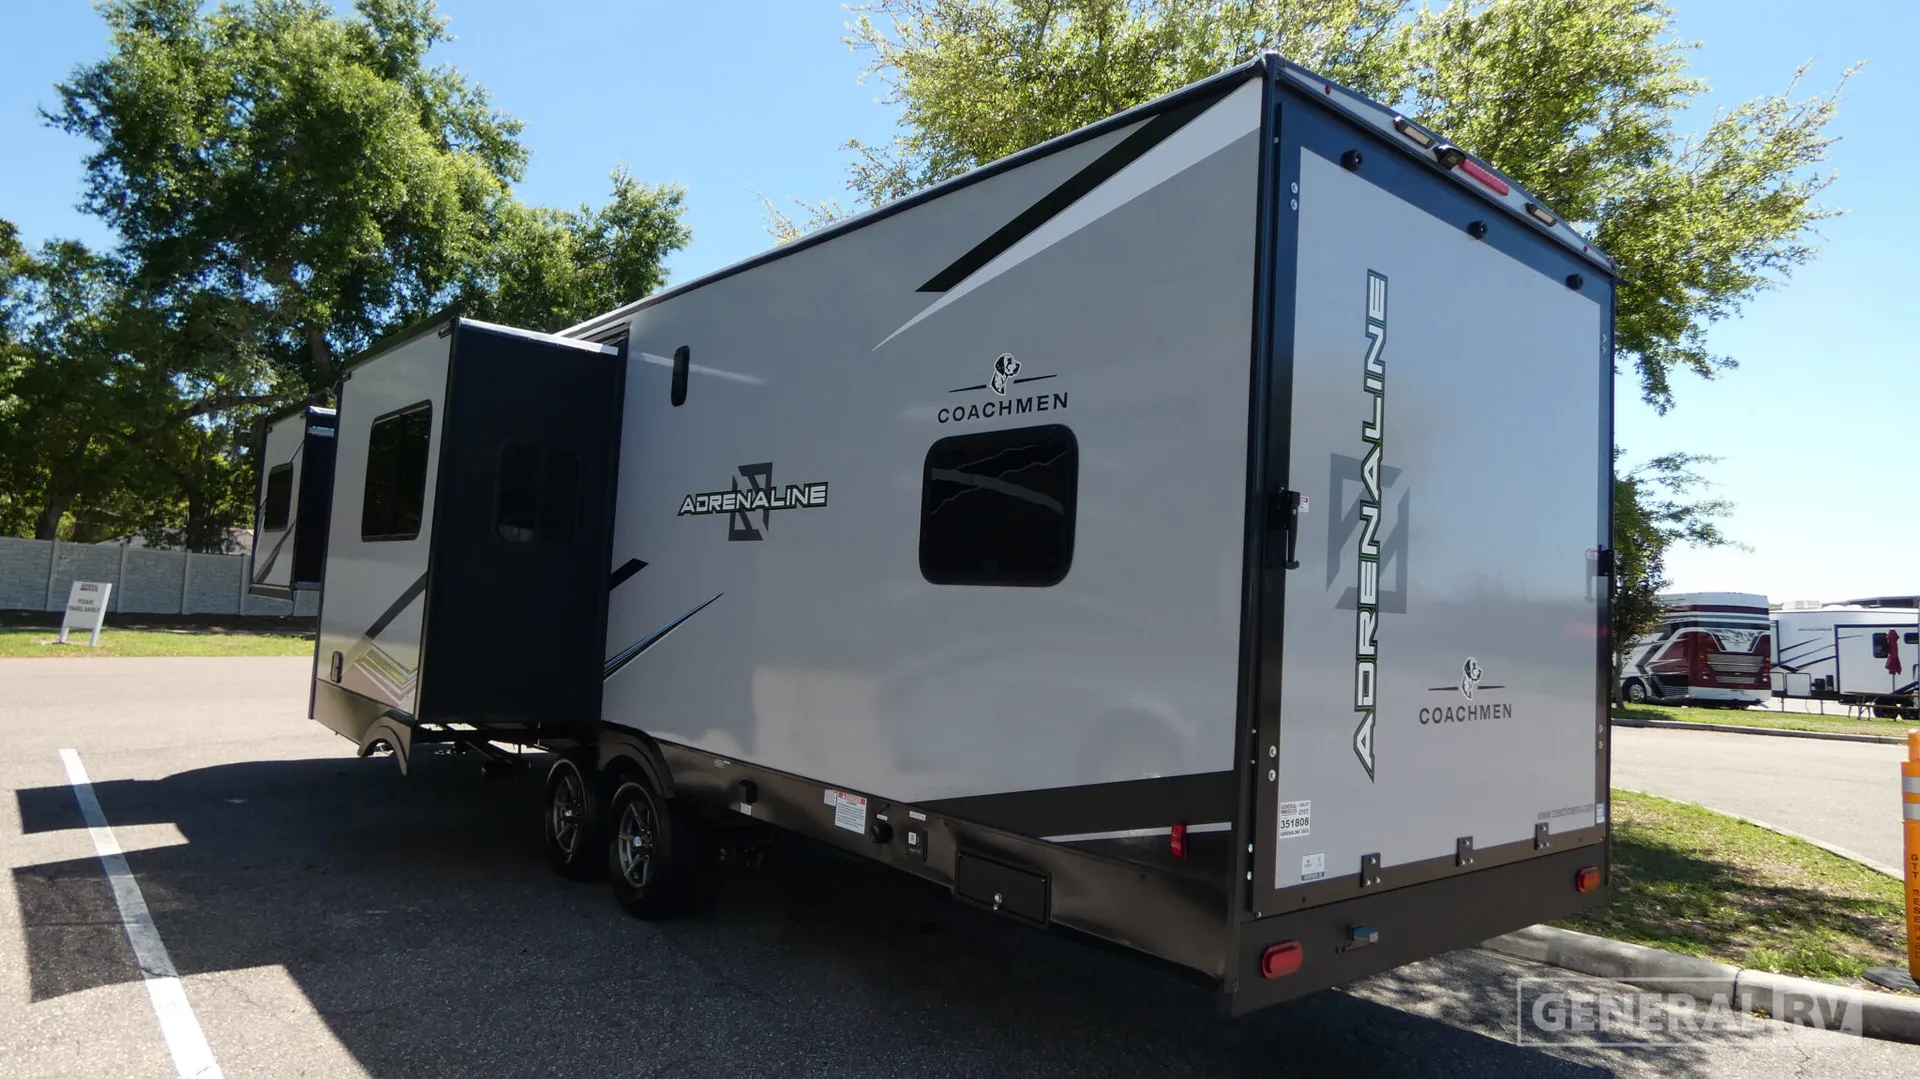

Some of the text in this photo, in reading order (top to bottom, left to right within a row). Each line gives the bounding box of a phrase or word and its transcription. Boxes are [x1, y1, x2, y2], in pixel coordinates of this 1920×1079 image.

[938, 392, 1069, 424] COACHMEN
[678, 481, 828, 516] ADRENALINE
[1353, 268, 1388, 784] ADRENALINE
[1419, 703, 1512, 725] COACHMEN
[1280, 817, 1309, 829] 351808
